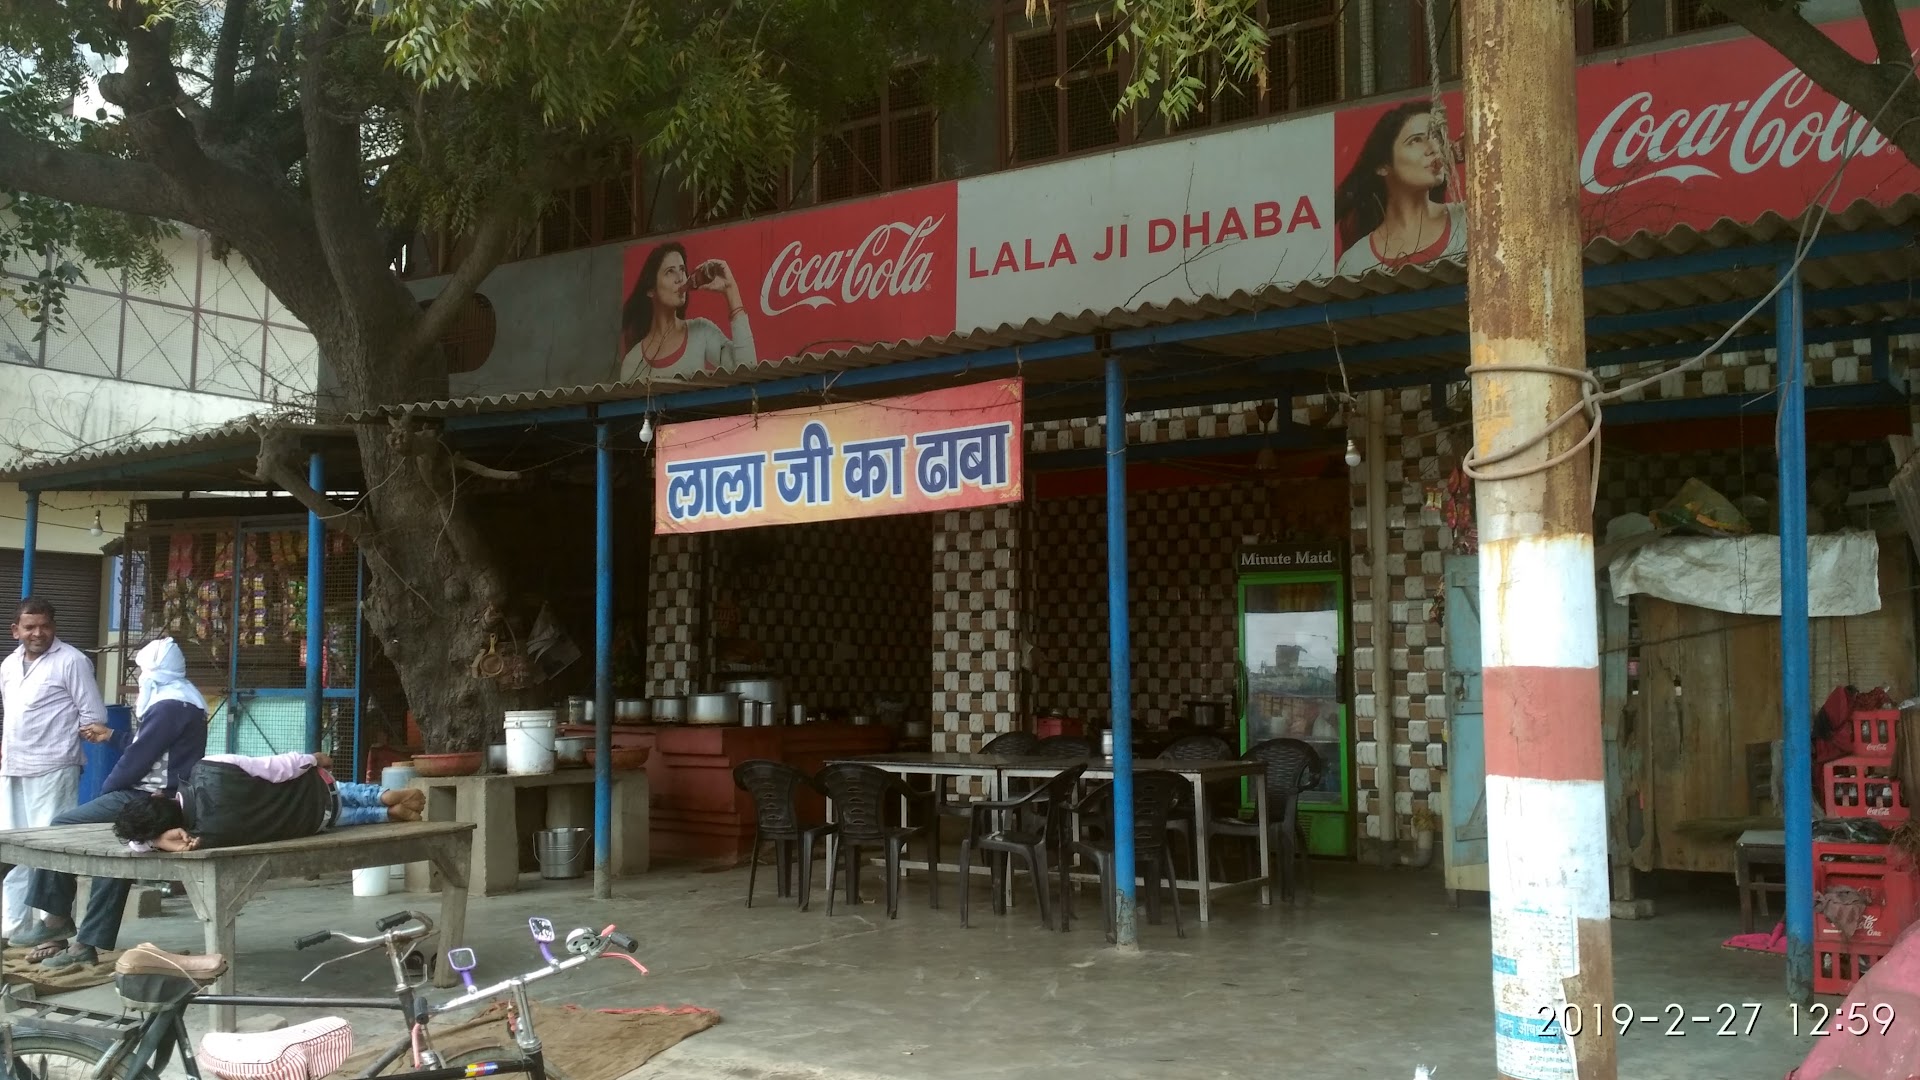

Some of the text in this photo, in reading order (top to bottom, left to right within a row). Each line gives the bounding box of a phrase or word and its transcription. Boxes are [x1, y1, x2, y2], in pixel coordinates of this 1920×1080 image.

[760, 213, 946, 316] Coca-Cola
[969, 195, 1322, 279] LALA JI DHABA
[666, 422, 1010, 521] लाला जी का ढाबा
[1241, 550, 1333, 566] Minute Maid
